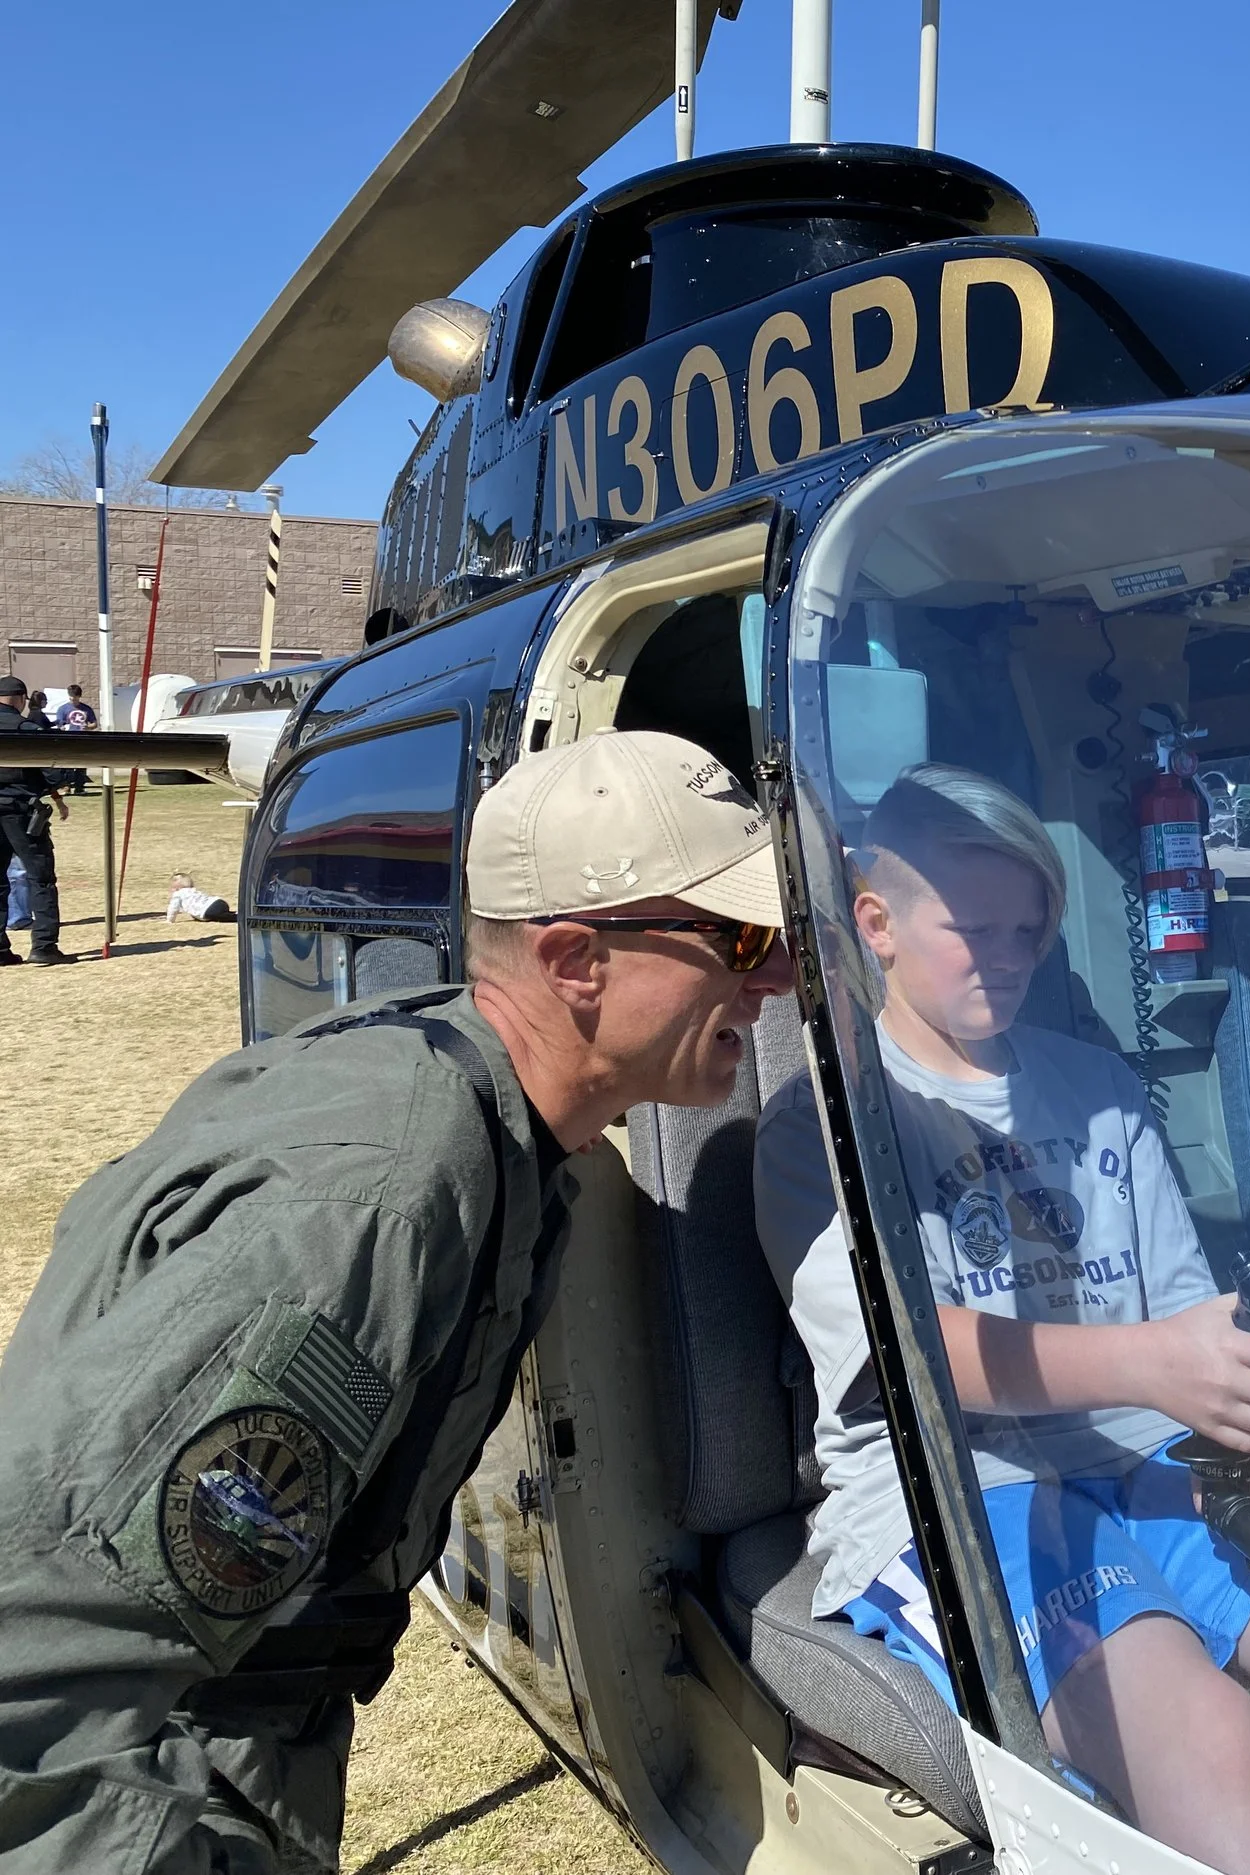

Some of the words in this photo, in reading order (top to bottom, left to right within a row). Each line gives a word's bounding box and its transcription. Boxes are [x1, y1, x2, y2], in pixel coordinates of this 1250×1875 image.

[555, 257, 1055, 531] N306PD
[686, 760, 723, 794] TUCSON
[744, 821, 760, 837] AIR
[955, 1255, 1069, 1298] UCSON
[1065, 1249, 1137, 1285] POLI
[231, 1413, 314, 1447] TUCSON
[169, 1470, 193, 1512] AIR
[167, 1524, 237, 1610] SUPPORT
[242, 1572, 286, 1610] UNIT
[1016, 1565, 1138, 1657] HARGERS
